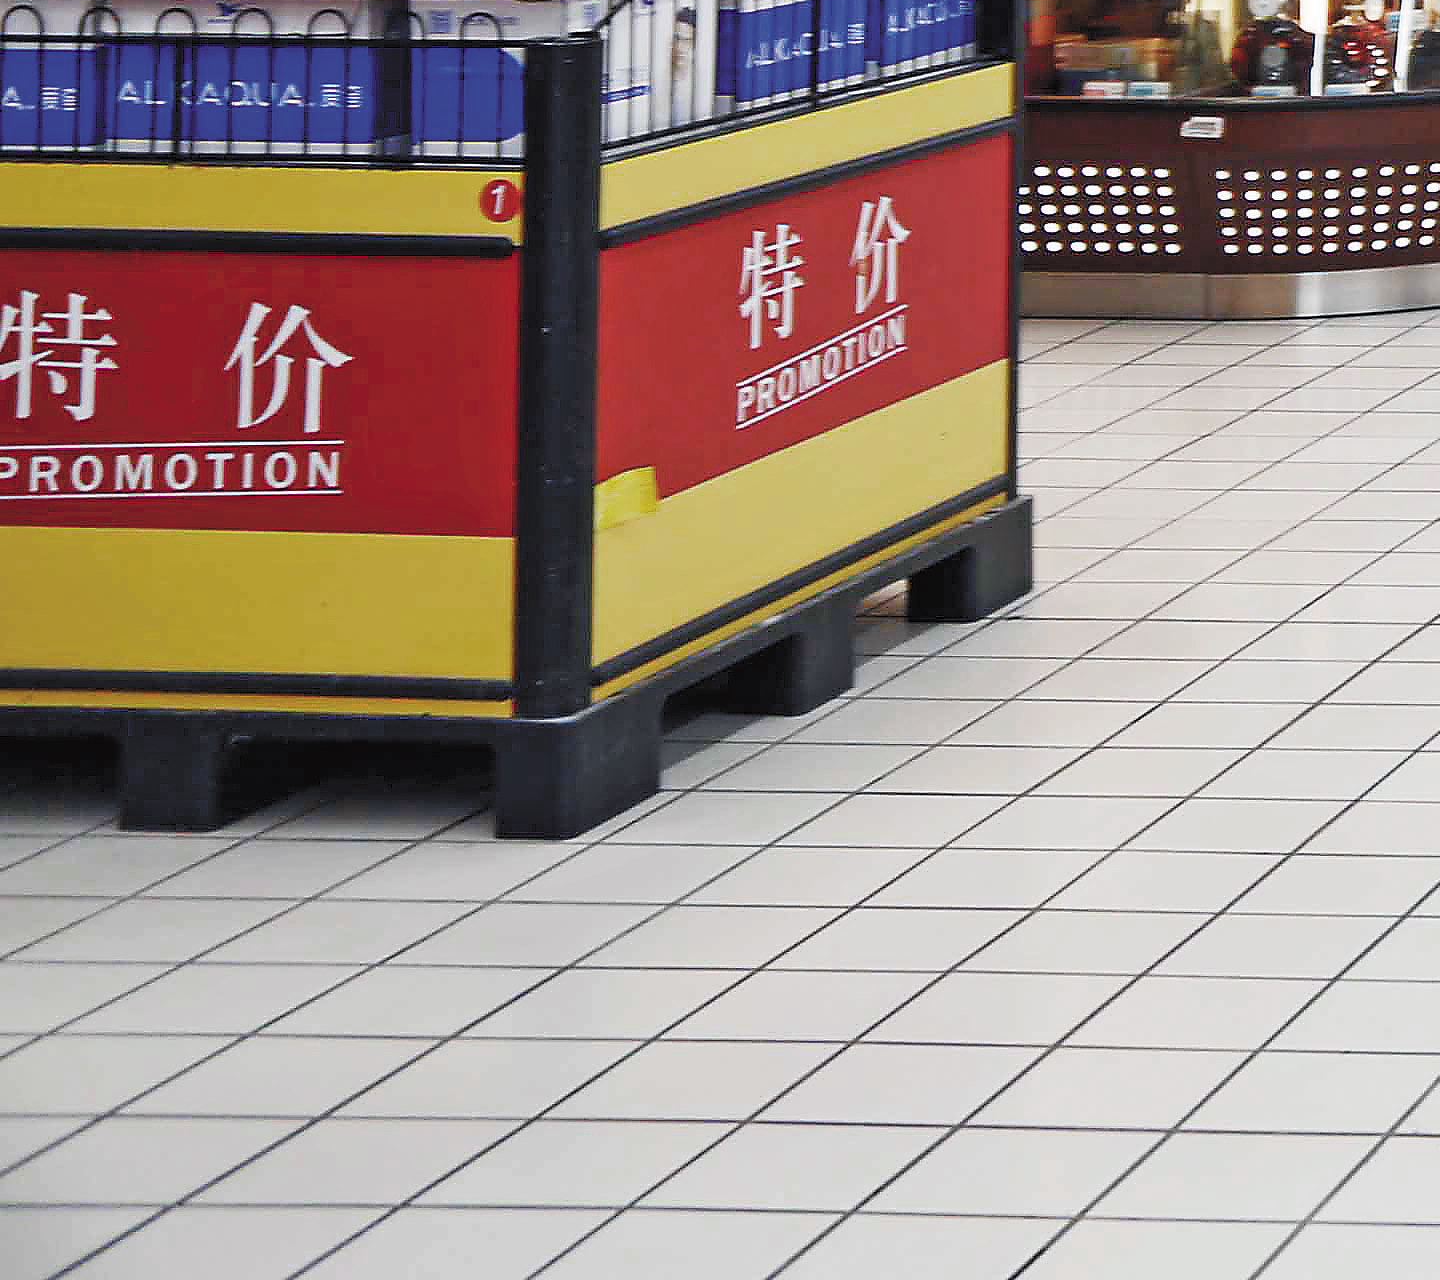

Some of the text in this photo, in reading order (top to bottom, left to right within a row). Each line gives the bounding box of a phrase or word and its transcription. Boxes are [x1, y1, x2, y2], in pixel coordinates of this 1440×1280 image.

[488, 183, 508, 216] 1
[739, 195, 912, 350] 特价
[0, 290, 354, 434] 特价
[735, 316, 909, 425] PROMOTION
[0, 449, 343, 493] PROMOTION
